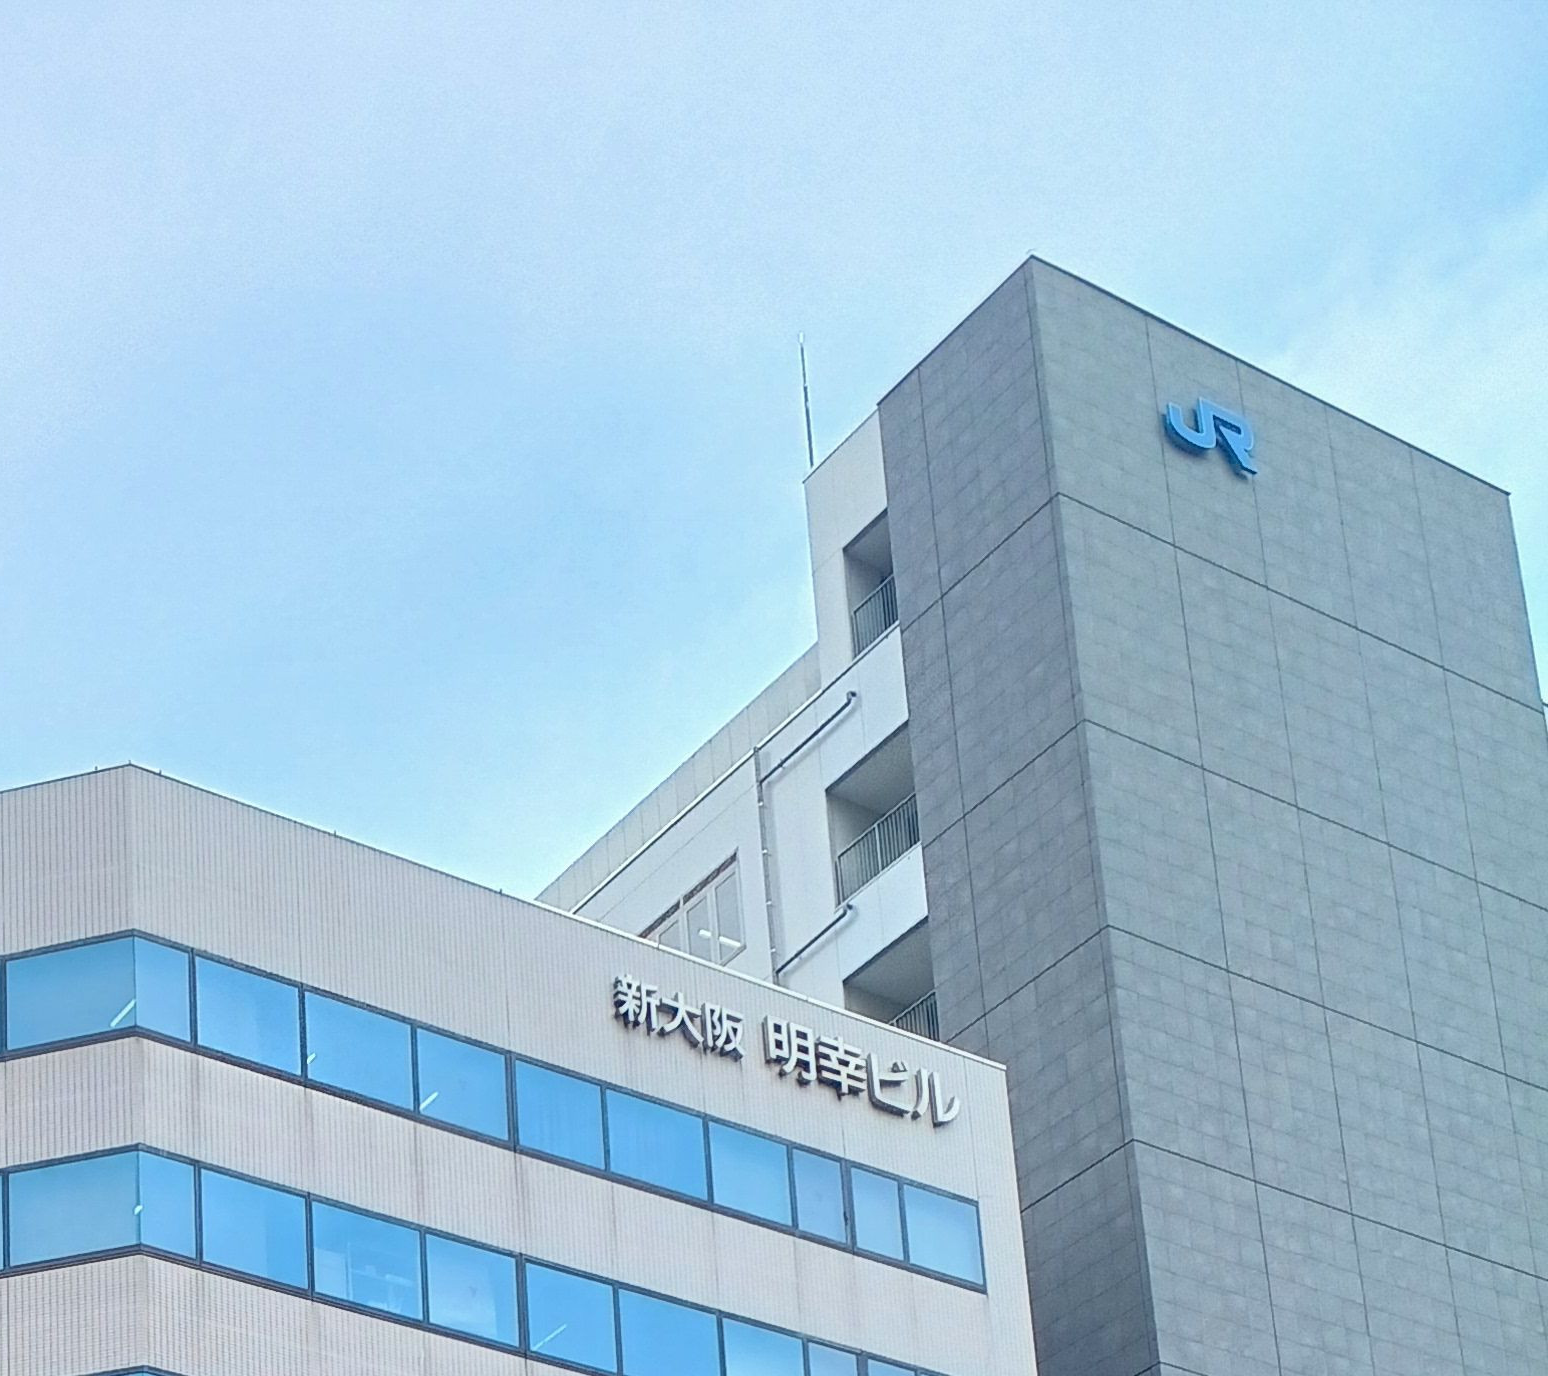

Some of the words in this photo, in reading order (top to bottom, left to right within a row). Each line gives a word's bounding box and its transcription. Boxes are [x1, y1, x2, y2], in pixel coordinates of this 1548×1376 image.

[1165, 397, 1258, 477] JR
[613, 973, 746, 1061] 新大阪
[761, 1014, 960, 1127] 明幸ビル
